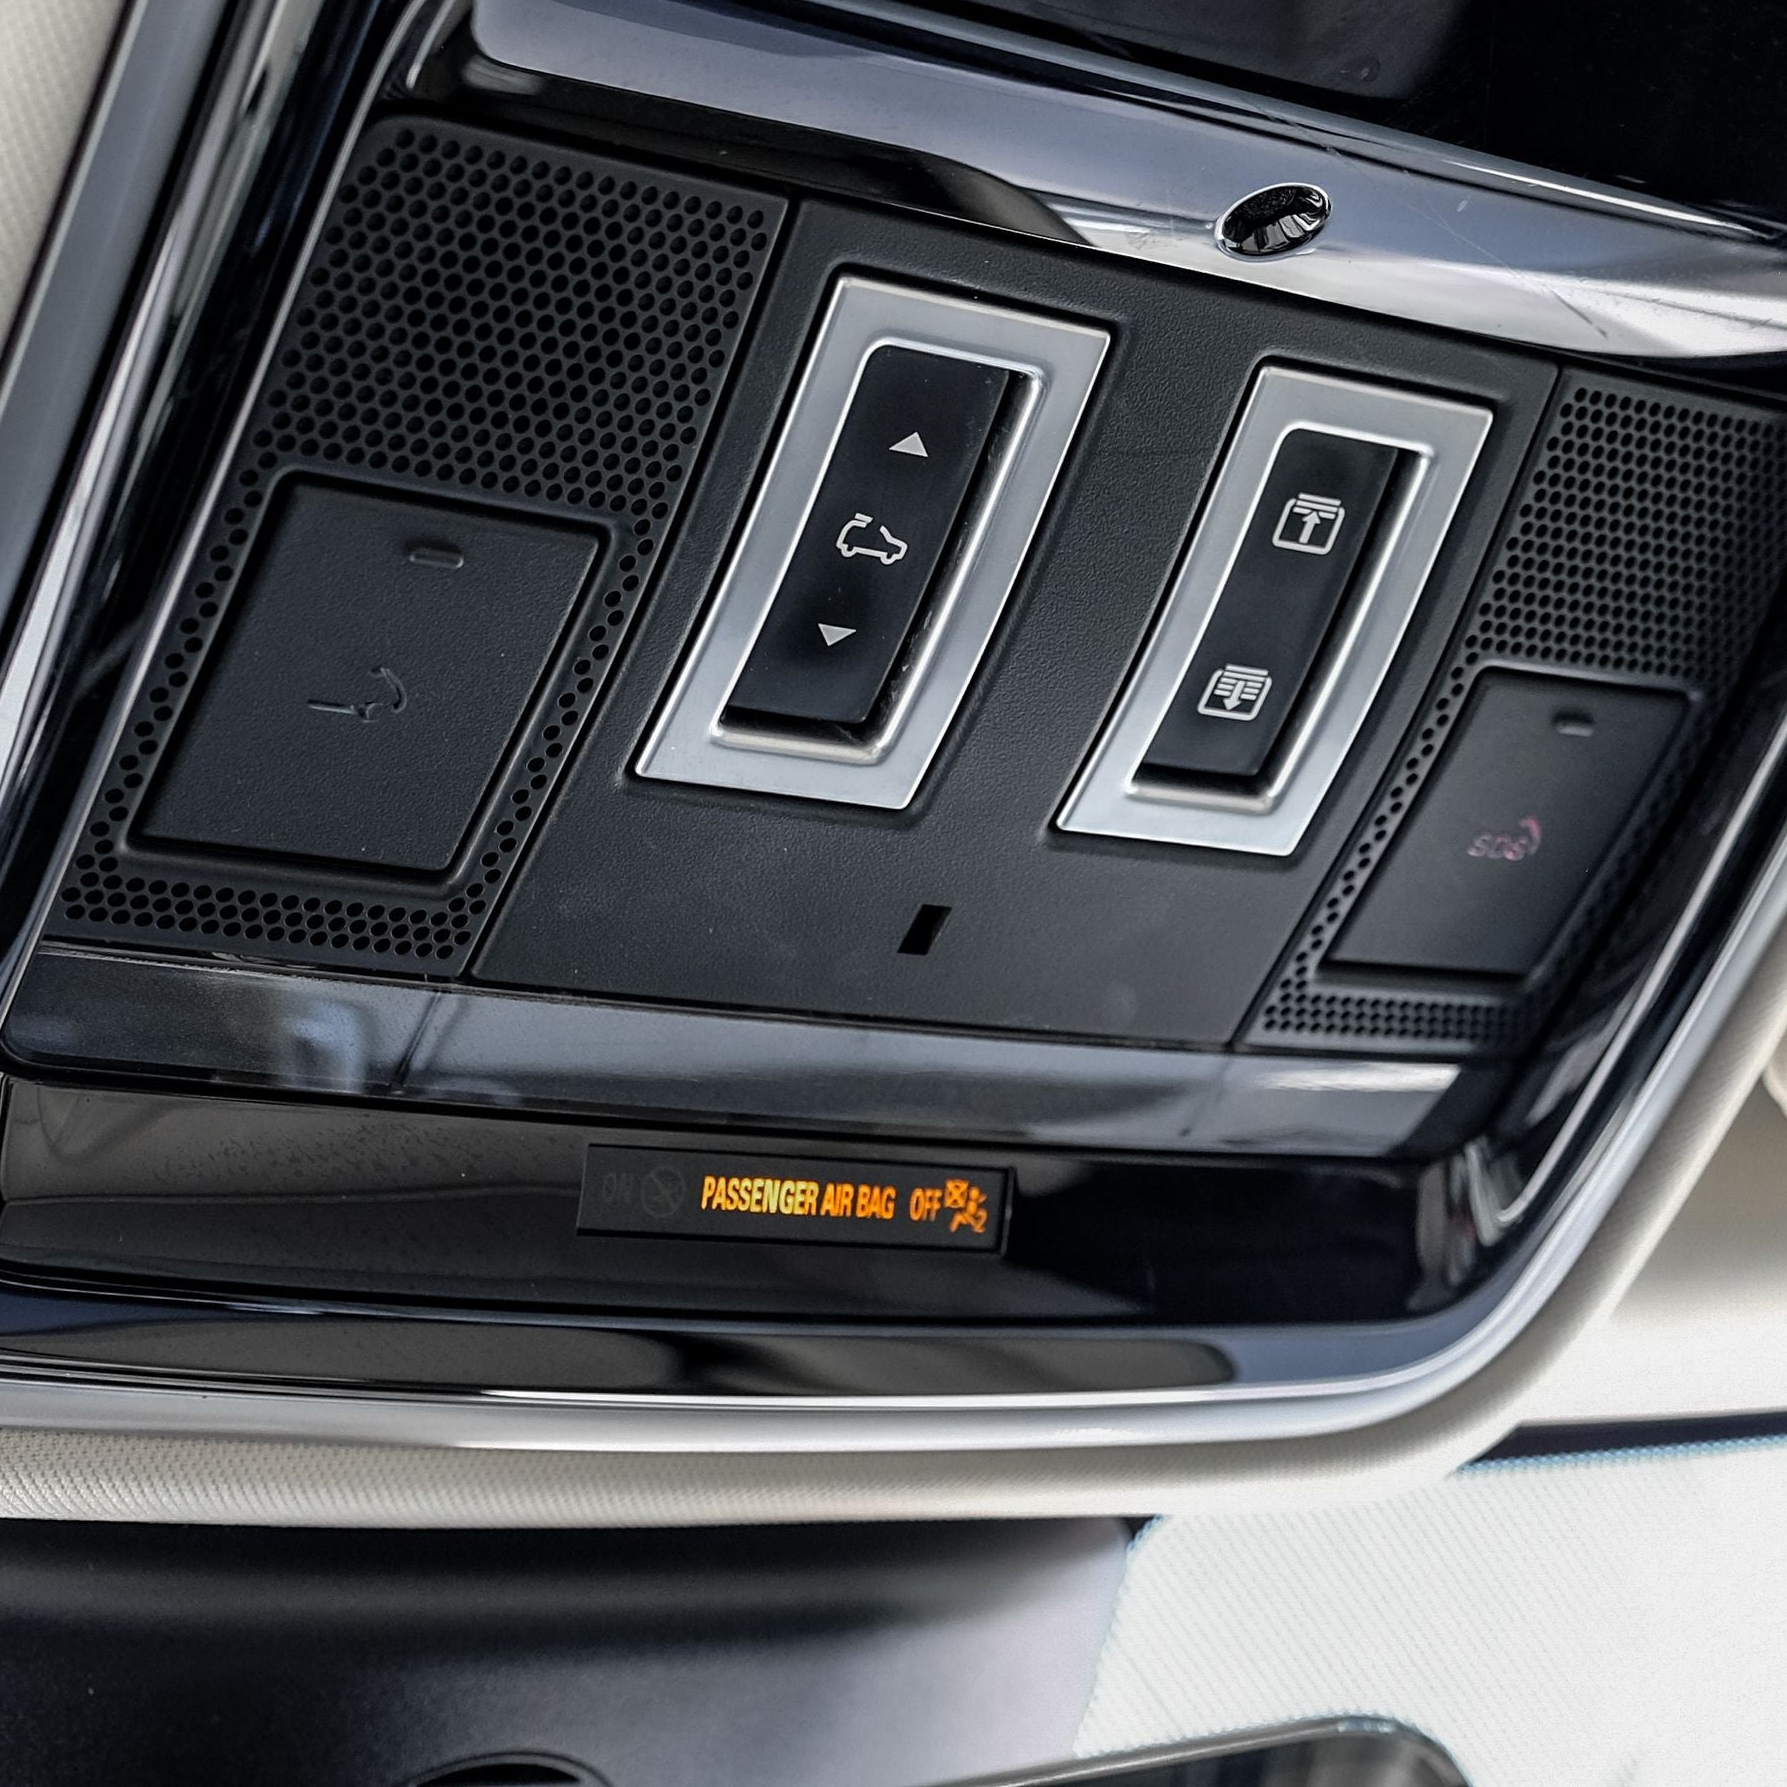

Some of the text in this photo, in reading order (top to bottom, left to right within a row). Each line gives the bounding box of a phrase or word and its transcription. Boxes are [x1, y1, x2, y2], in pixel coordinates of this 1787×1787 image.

[701, 1175, 818, 1216] PASSENGER
[820, 1182, 855, 1218] AIR
[856, 1184, 897, 1221] BAG
[908, 1186, 943, 1223] OFF
